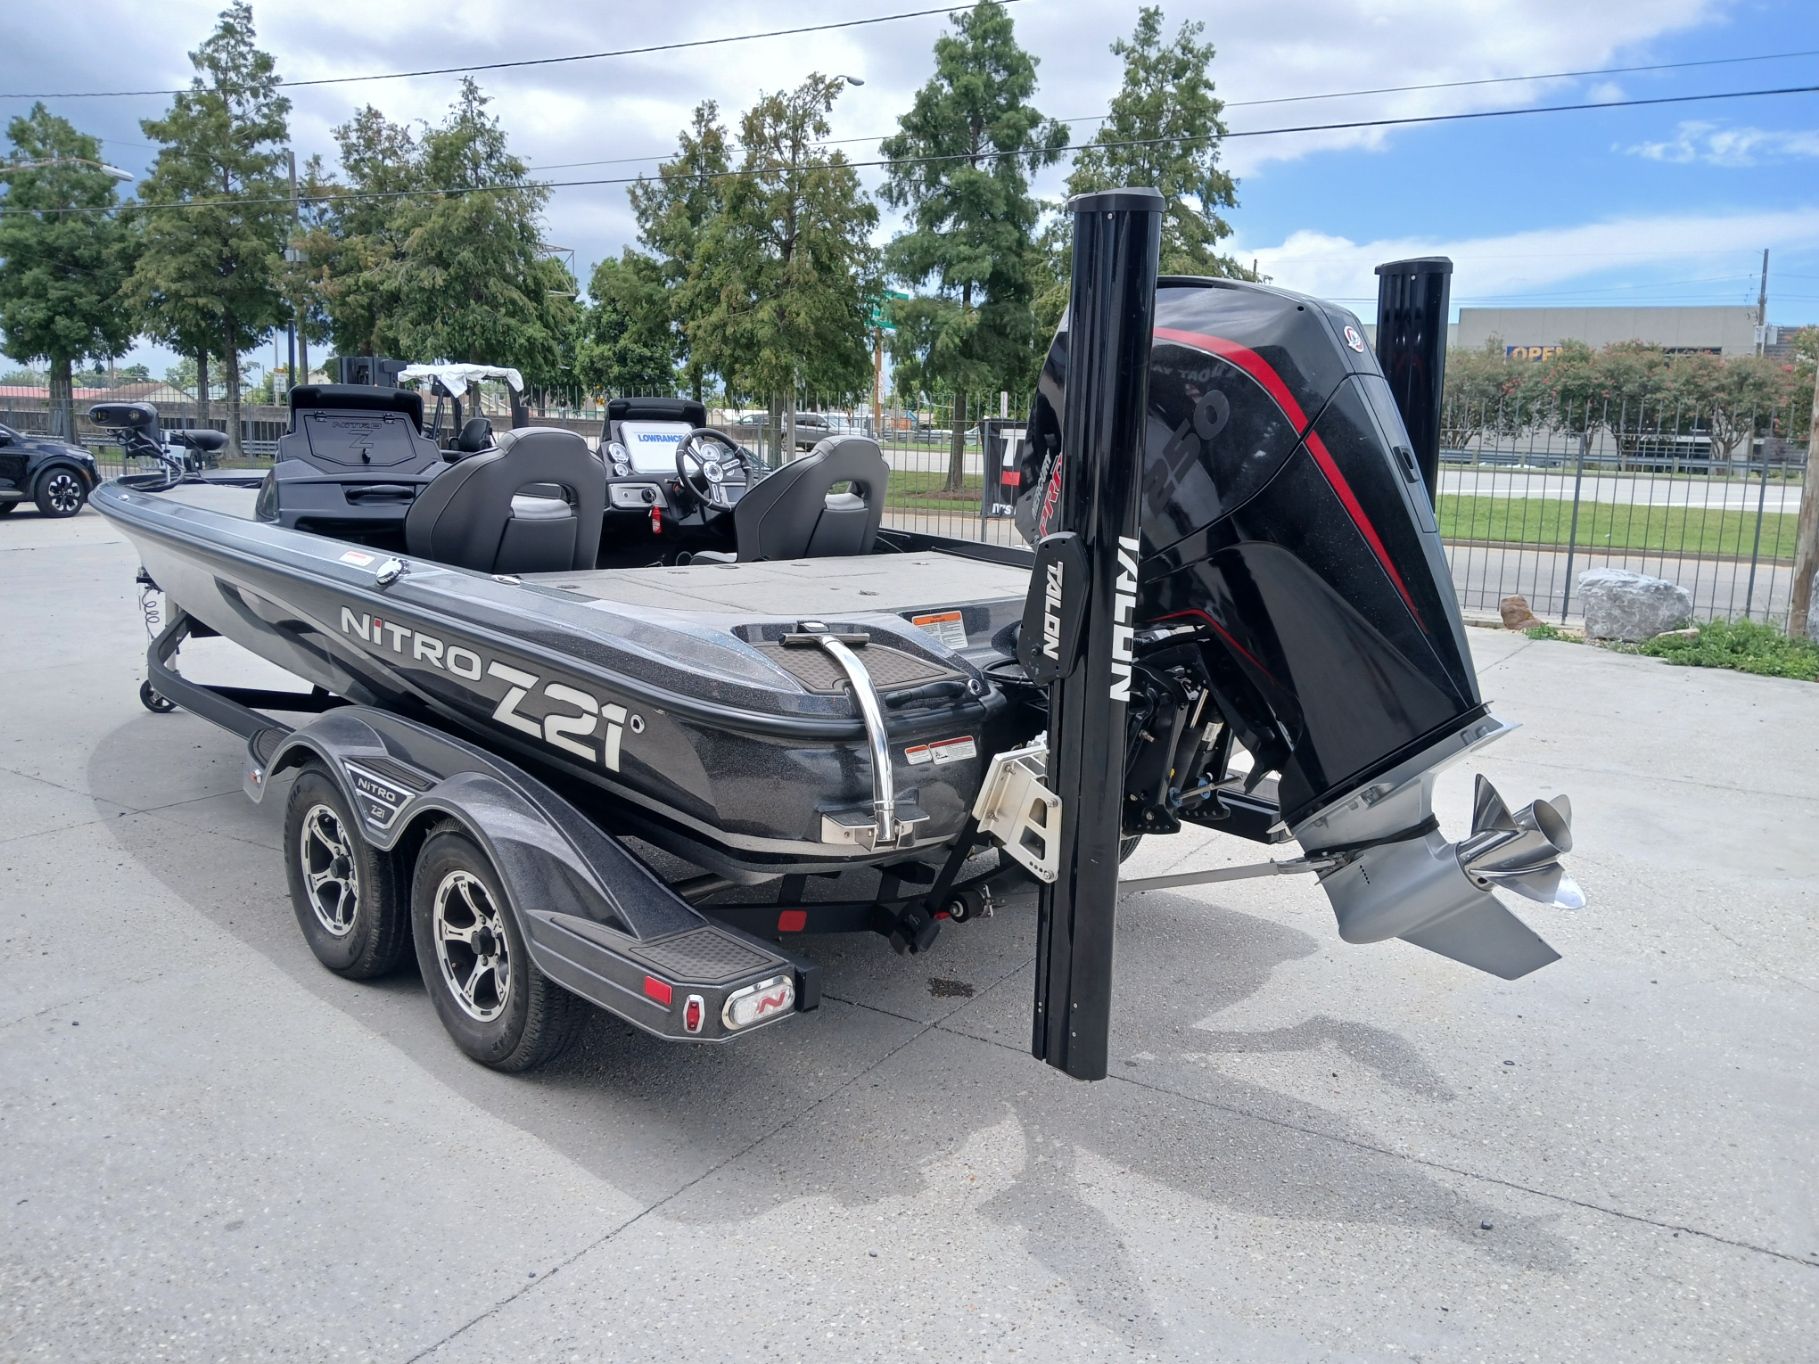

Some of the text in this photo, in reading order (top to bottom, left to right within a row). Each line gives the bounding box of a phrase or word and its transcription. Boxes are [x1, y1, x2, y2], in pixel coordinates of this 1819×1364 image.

[638, 434, 683, 443] LOWRANCE
[1043, 561, 1064, 661] TALON
[341, 606, 482, 681] NITRO
[358, 777, 396, 802] NITRO
